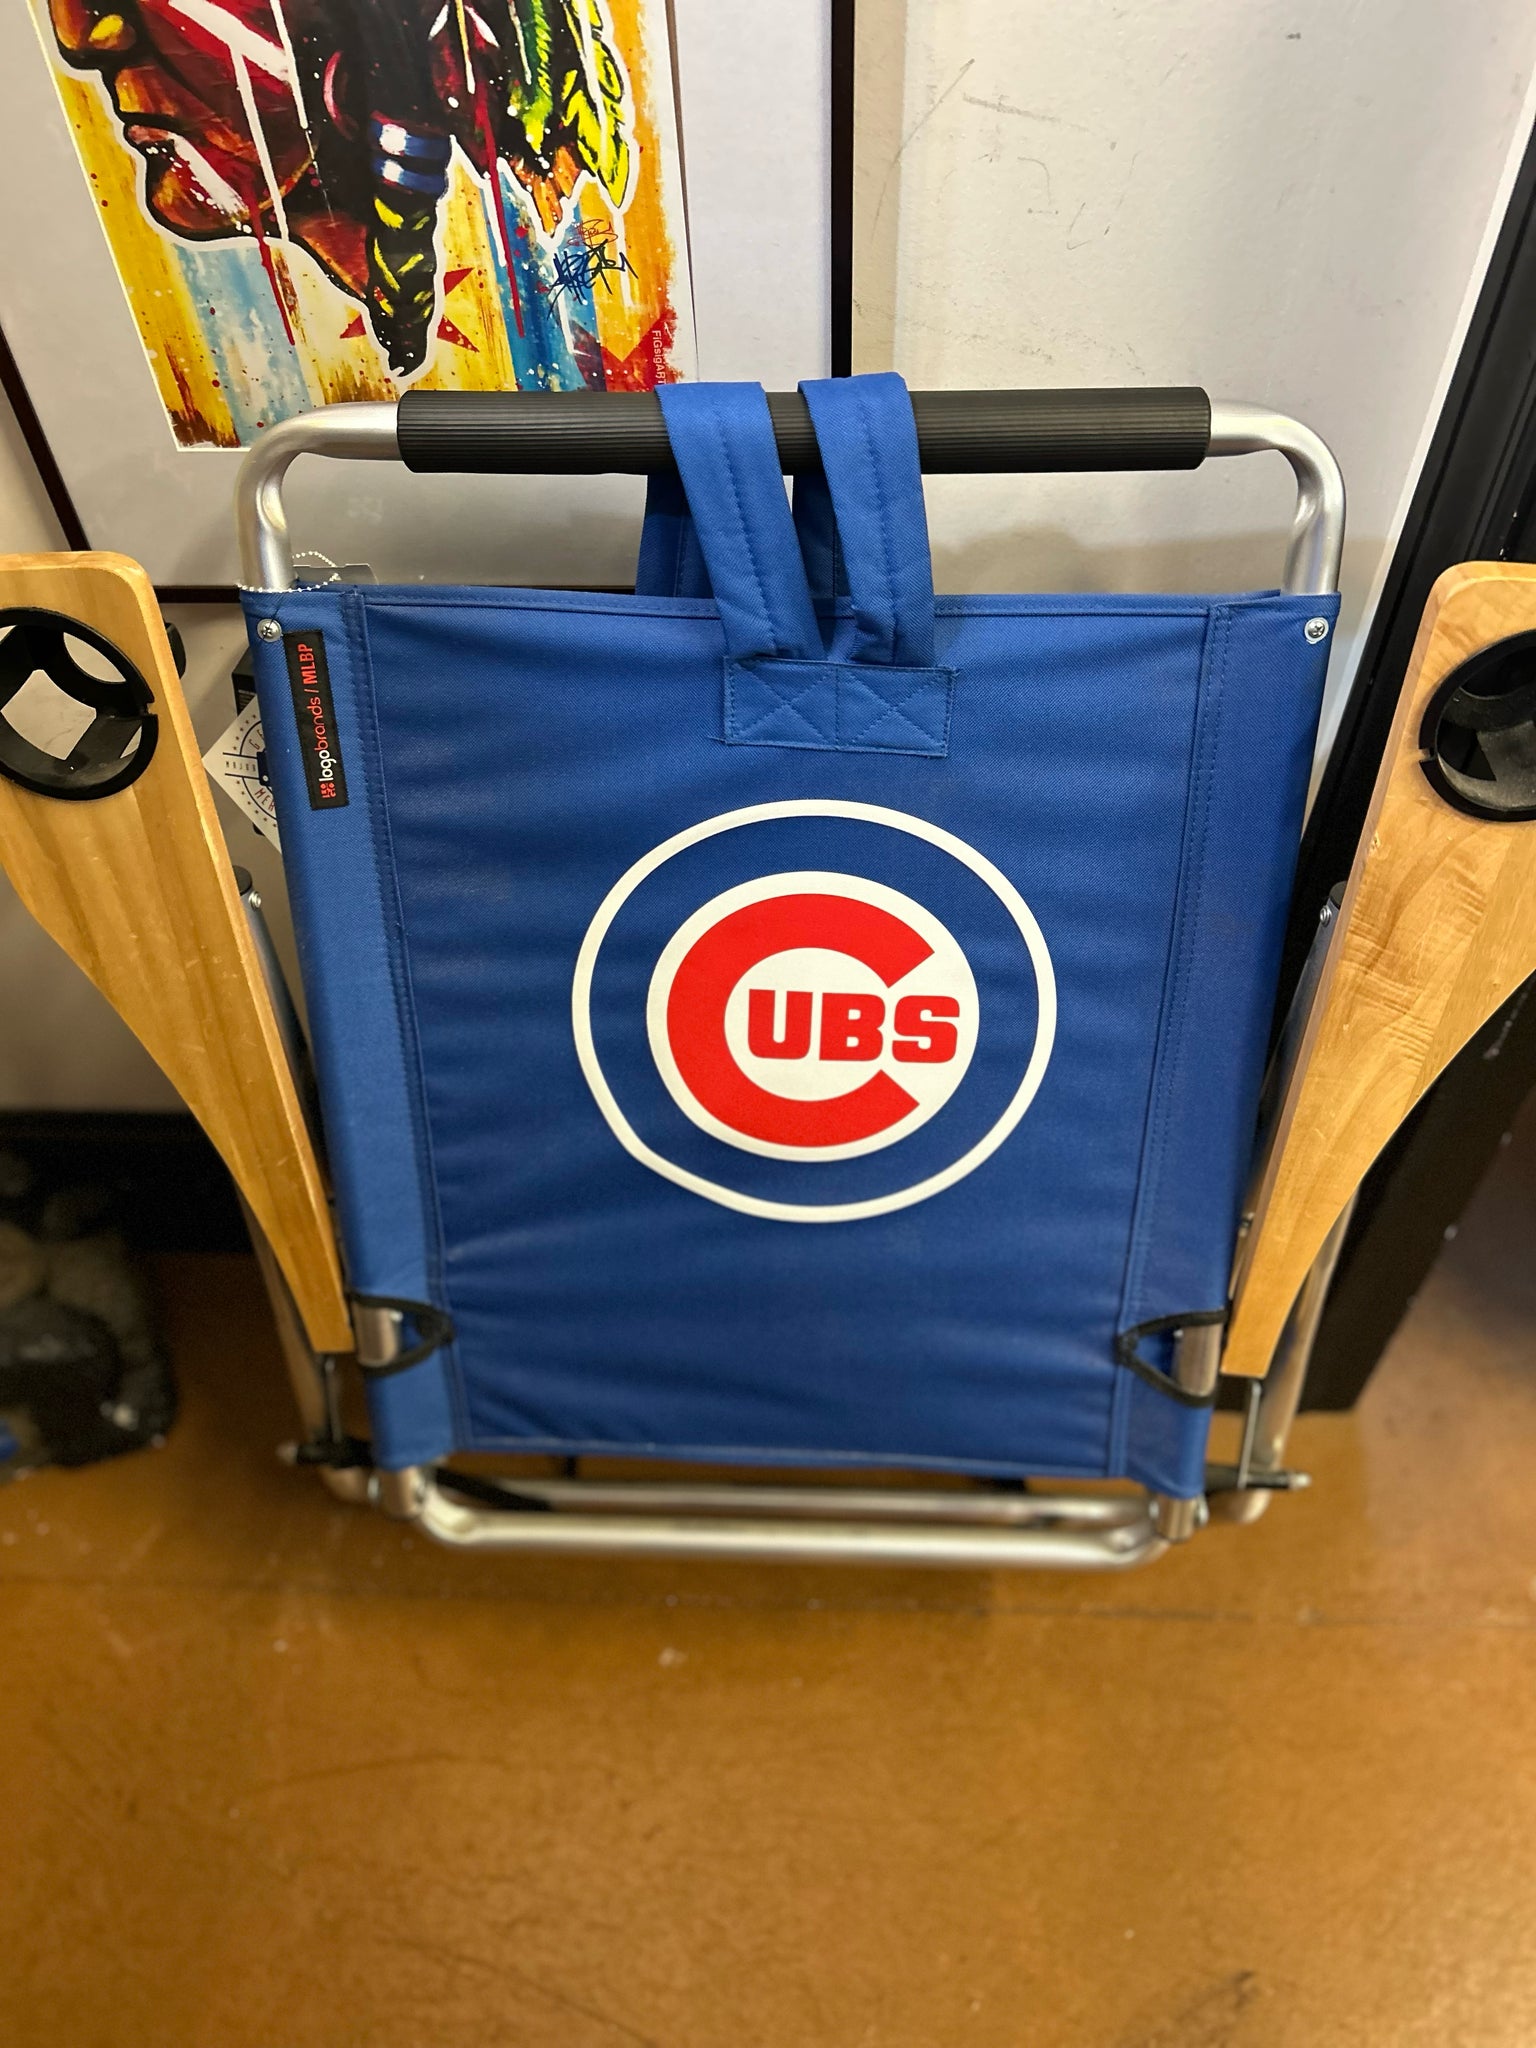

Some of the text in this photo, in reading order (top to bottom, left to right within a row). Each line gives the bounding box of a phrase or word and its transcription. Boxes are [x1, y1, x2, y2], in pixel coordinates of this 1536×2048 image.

[298, 644, 317, 684] MLBP
[308, 697, 336, 781] logobrands
[666, 893, 960, 1148] CUBS
